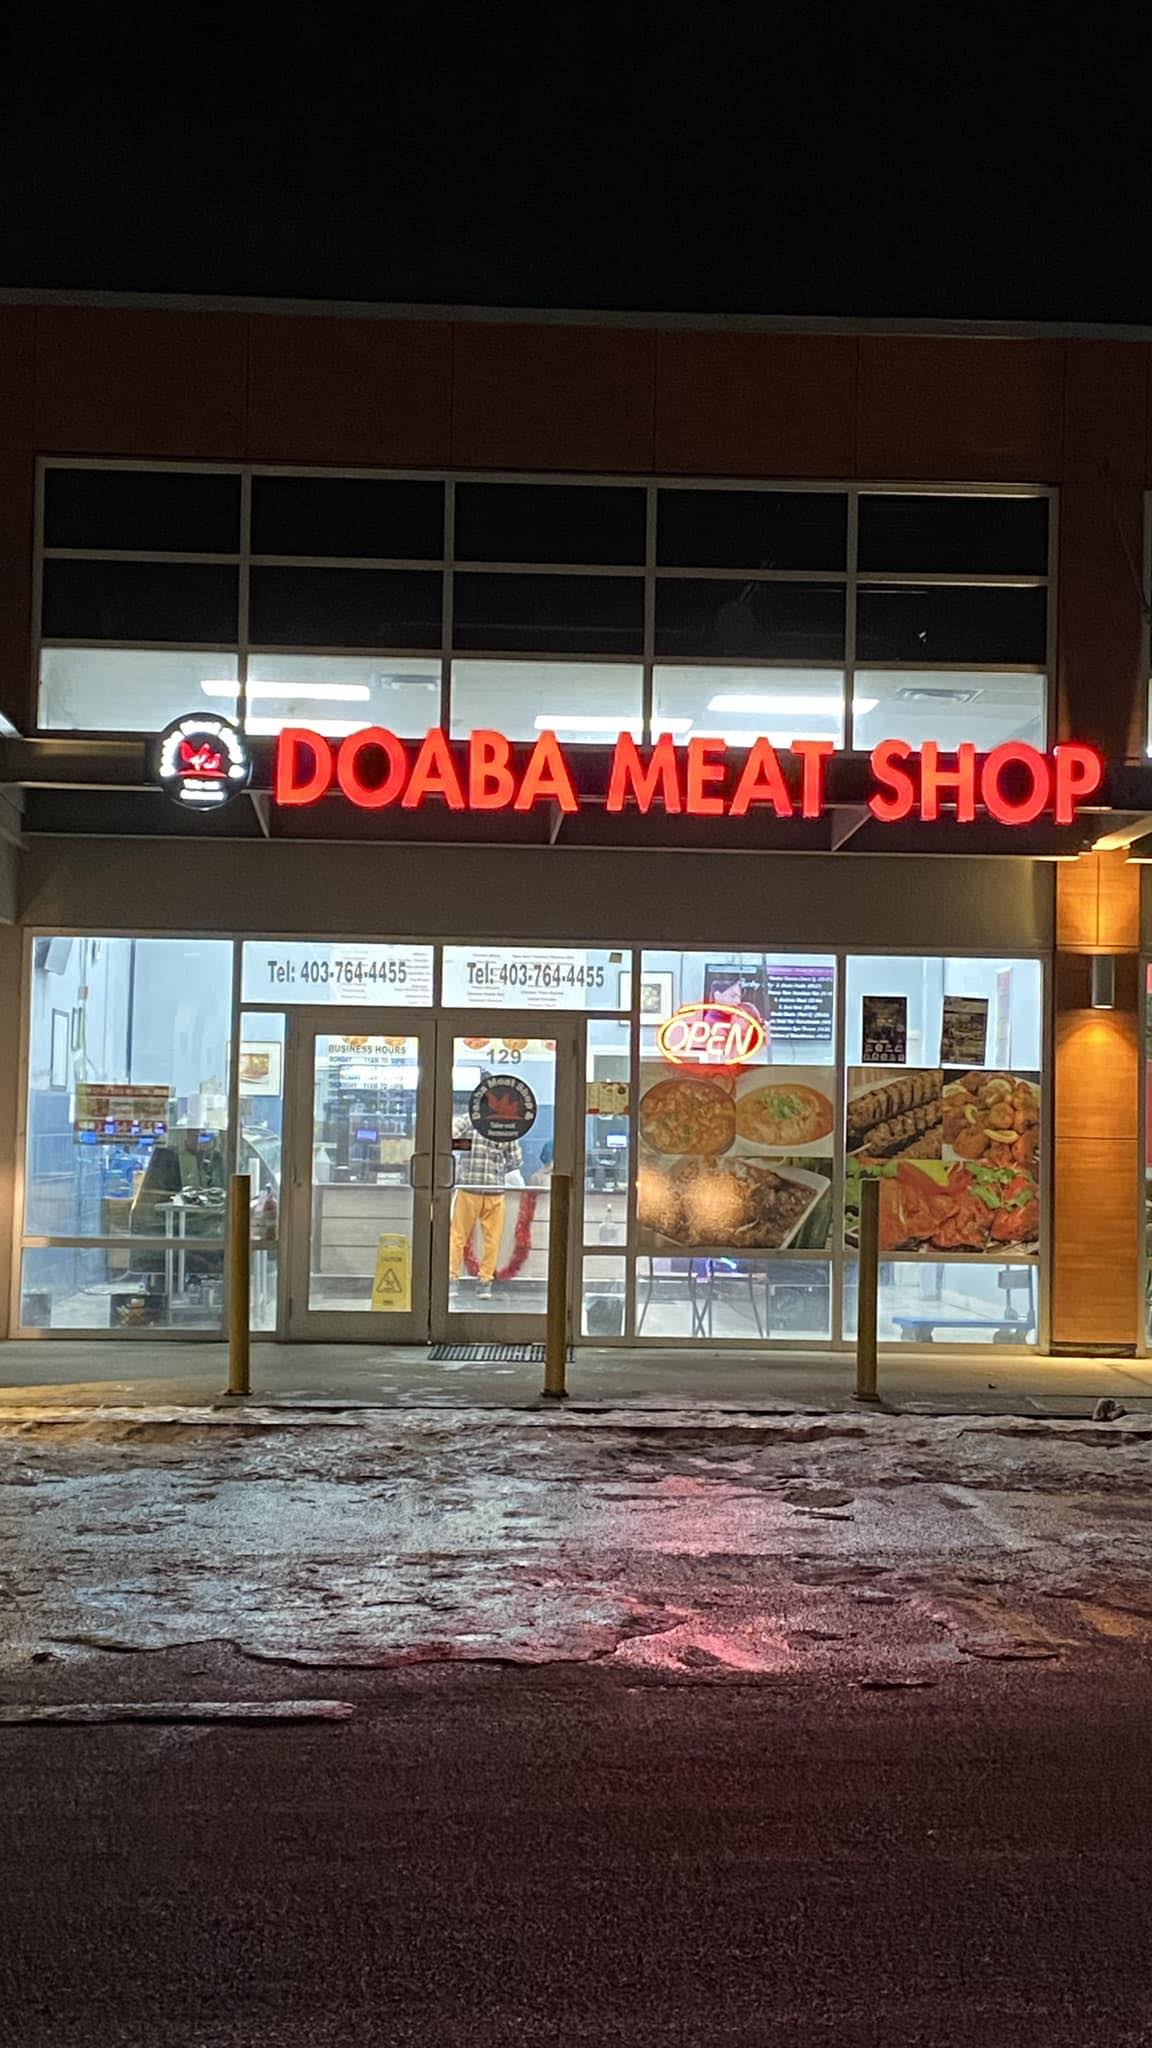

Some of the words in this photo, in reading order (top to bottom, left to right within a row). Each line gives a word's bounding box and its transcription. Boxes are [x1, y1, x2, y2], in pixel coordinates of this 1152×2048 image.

[276, 725, 578, 812] DOABA
[606, 731, 835, 818] MEAT
[869, 738, 1101, 825] SHOP
[267, 960, 296, 983] Tel:
[301, 961, 407, 983] 403-764-4455
[466, 962, 494, 985] Tel:
[499, 963, 605, 987] 403-764-4455
[328, 1044, 373, 1054] BUSINESS
[375, 1046, 406, 1054] HOURS
[663, 1020, 755, 1056] OPEN
[486, 1049, 521, 1064] 129
[487, 1078, 516, 1089] Meat
[515, 1083, 533, 1109] Shop
